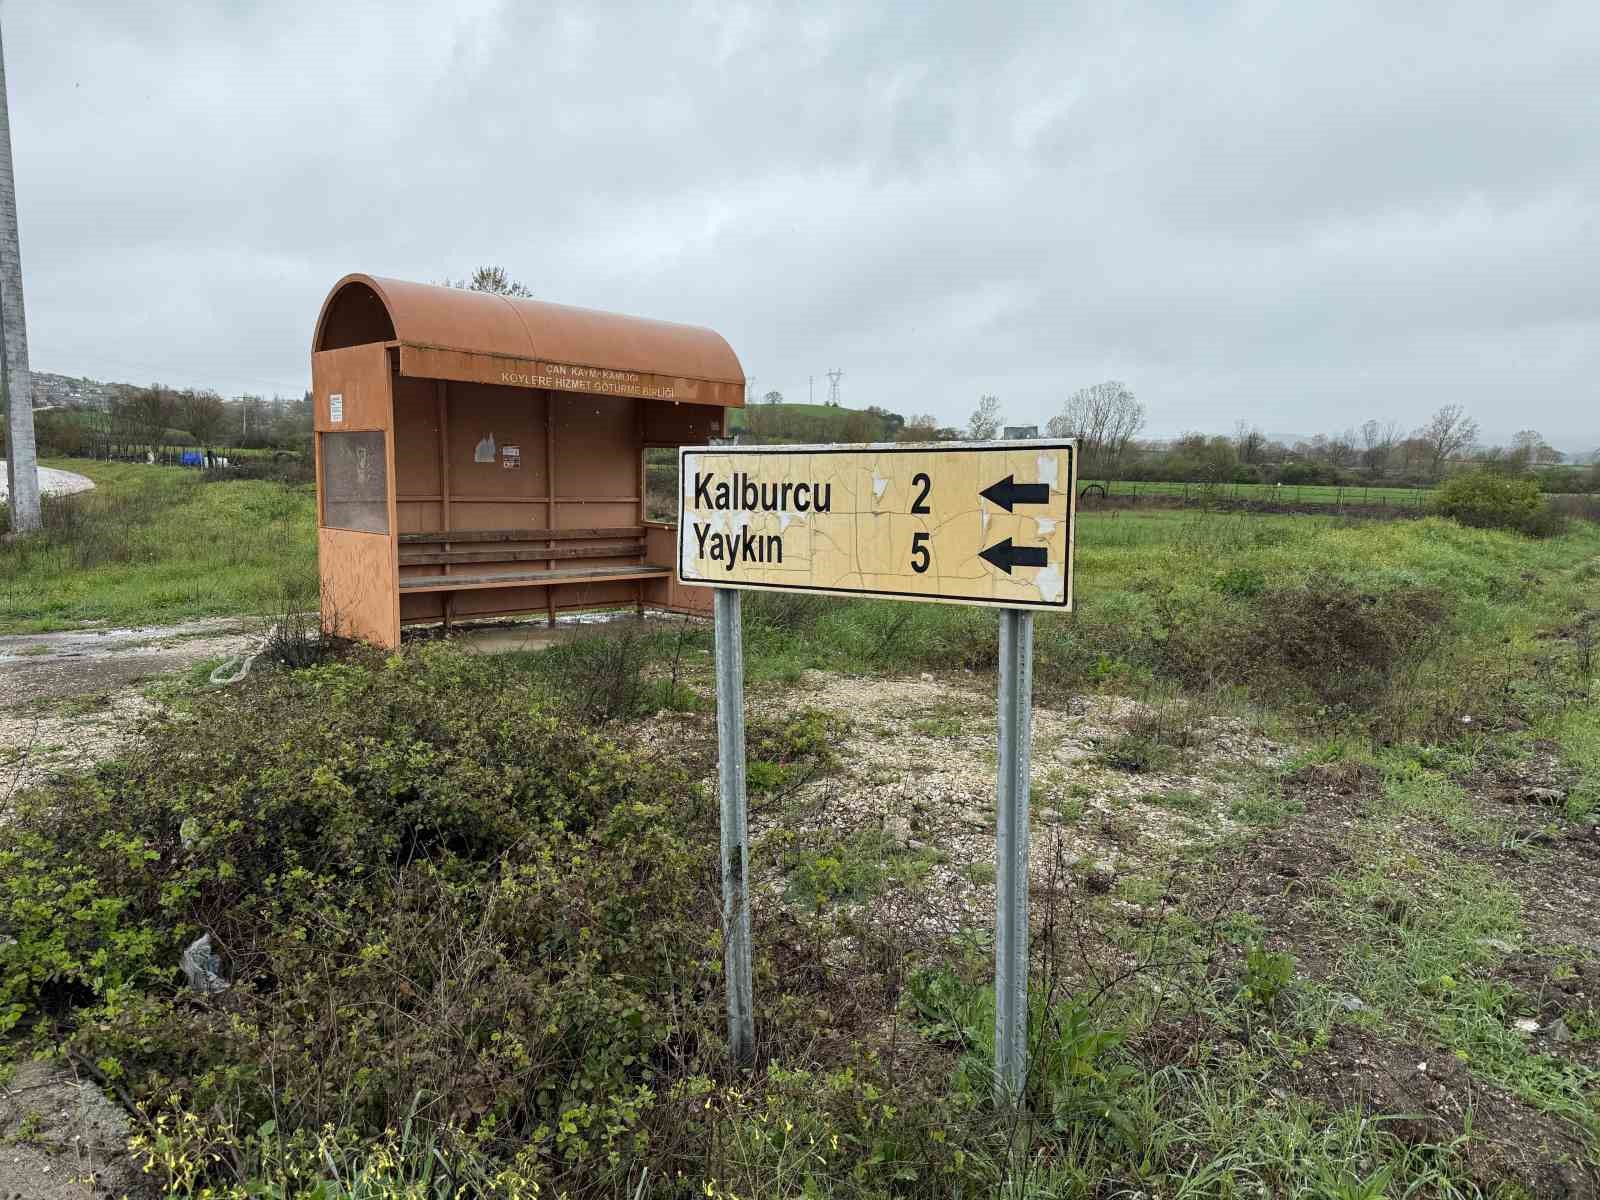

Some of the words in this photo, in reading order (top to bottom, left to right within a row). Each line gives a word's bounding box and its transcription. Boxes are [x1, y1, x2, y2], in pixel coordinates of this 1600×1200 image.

[694, 472, 831, 513] Kalburcu
[911, 473, 931, 514] 2
[694, 523, 783, 571] Yaykın
[911, 532, 931, 574] 5
